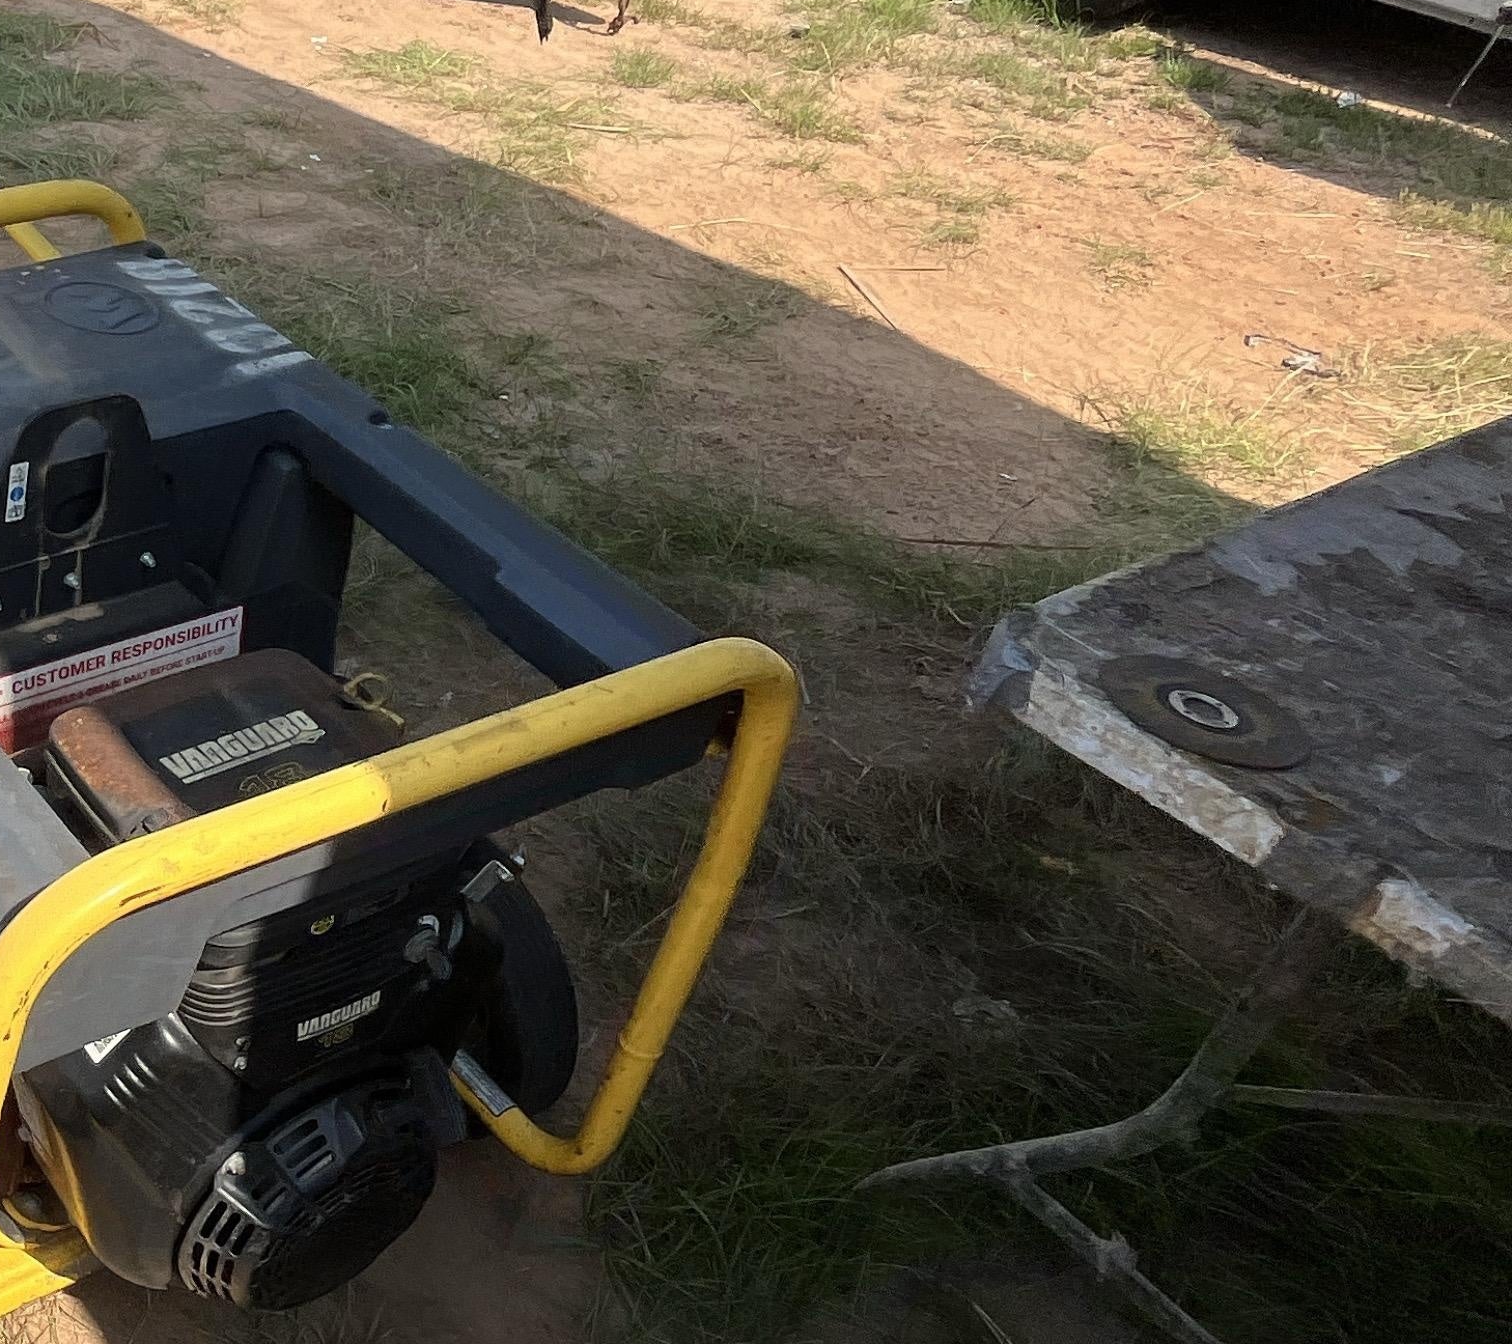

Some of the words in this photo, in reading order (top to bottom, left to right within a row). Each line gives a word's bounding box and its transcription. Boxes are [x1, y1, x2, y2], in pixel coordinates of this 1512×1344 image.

[11, 656, 106, 695] CUSTOMER
[110, 613, 240, 665] RESPONSIBILITY
[158, 709, 320, 780] VANGUARD
[297, 989, 382, 1038] VANGUARD
